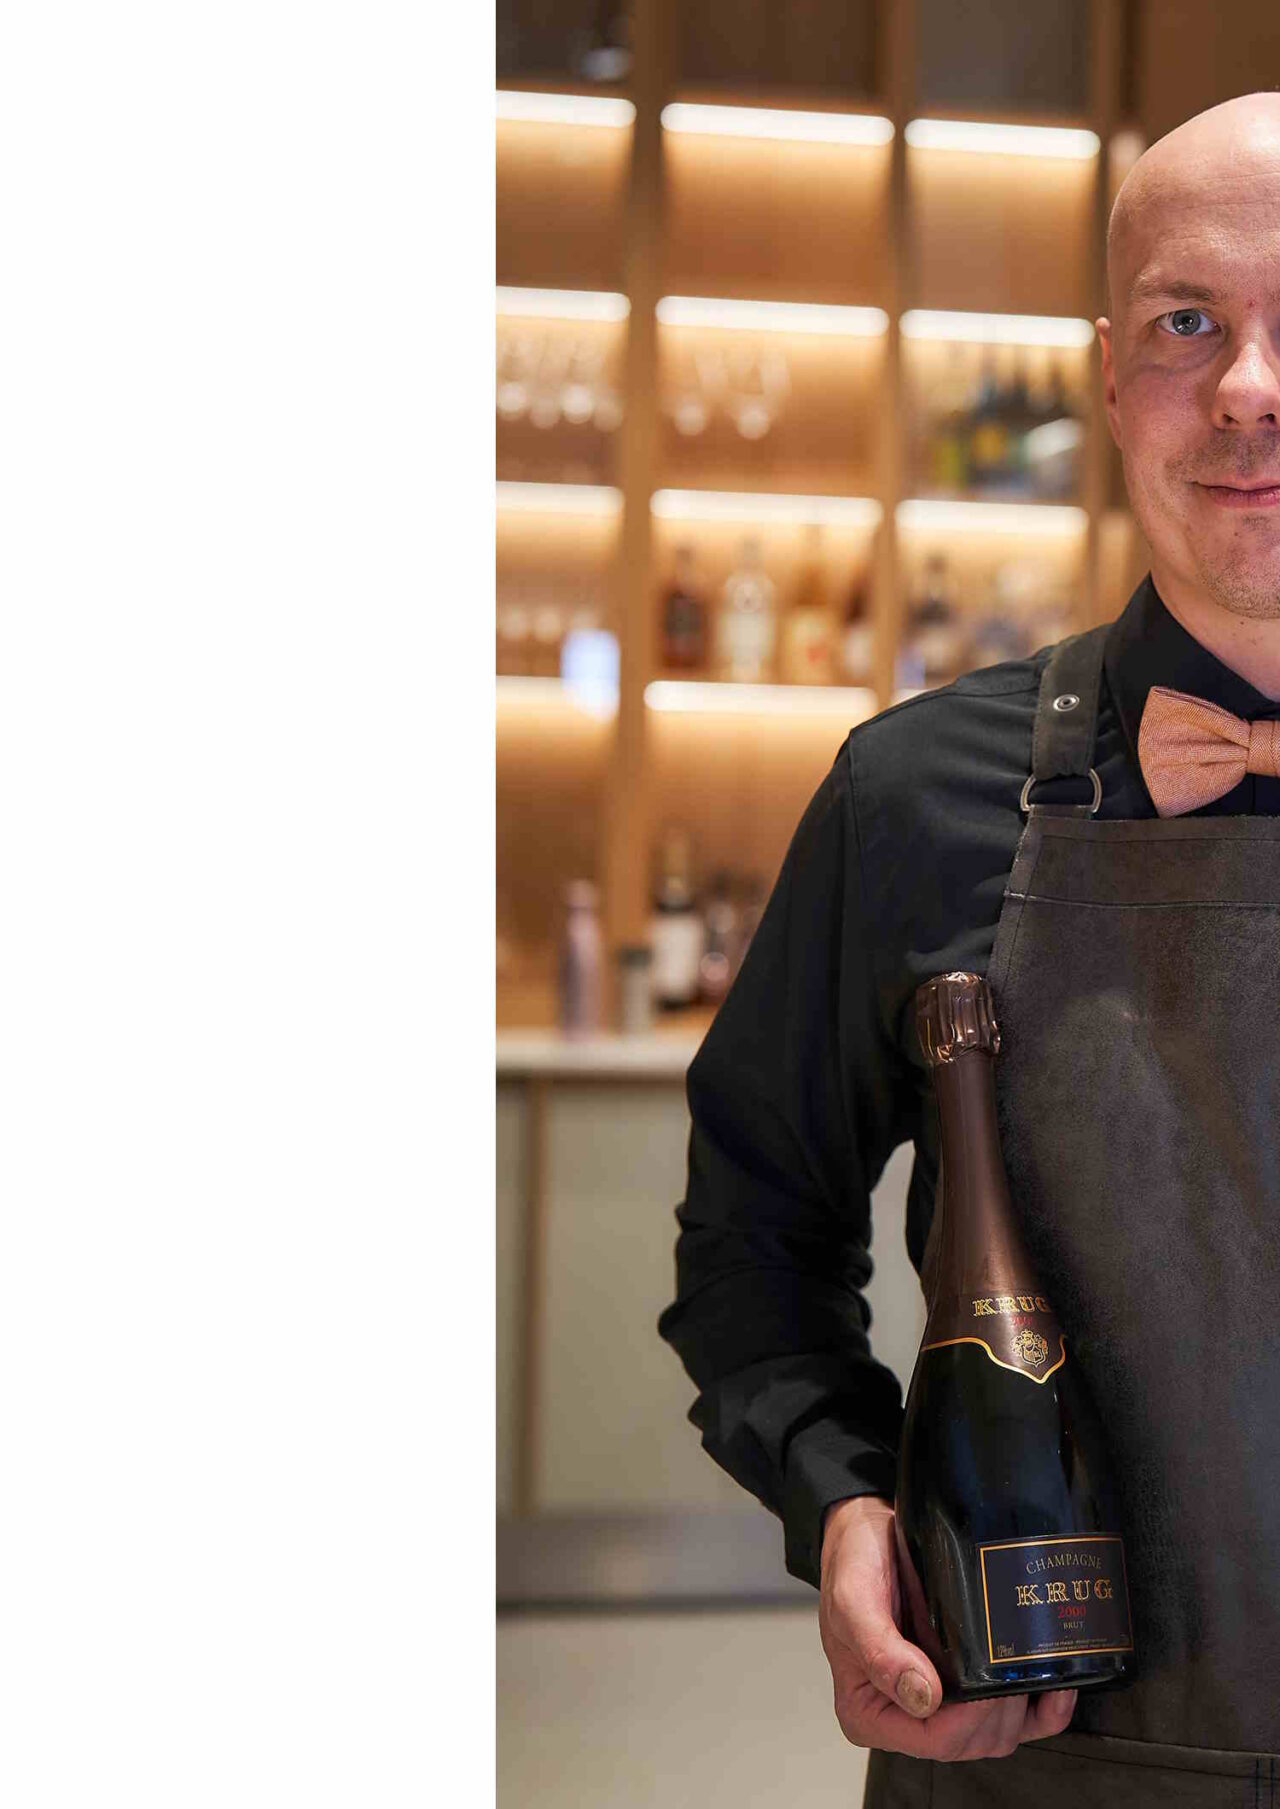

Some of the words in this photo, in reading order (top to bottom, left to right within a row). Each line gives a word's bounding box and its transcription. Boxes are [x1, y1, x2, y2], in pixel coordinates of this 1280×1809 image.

[972, 1296, 1050, 1317] KRUG
[1025, 1552, 1103, 1575] CHAMPAGNE
[1015, 1577, 1113, 1607] KRUG
[1057, 1605, 1087, 1619] 2000
[1063, 1621, 1085, 1630] BRUT
